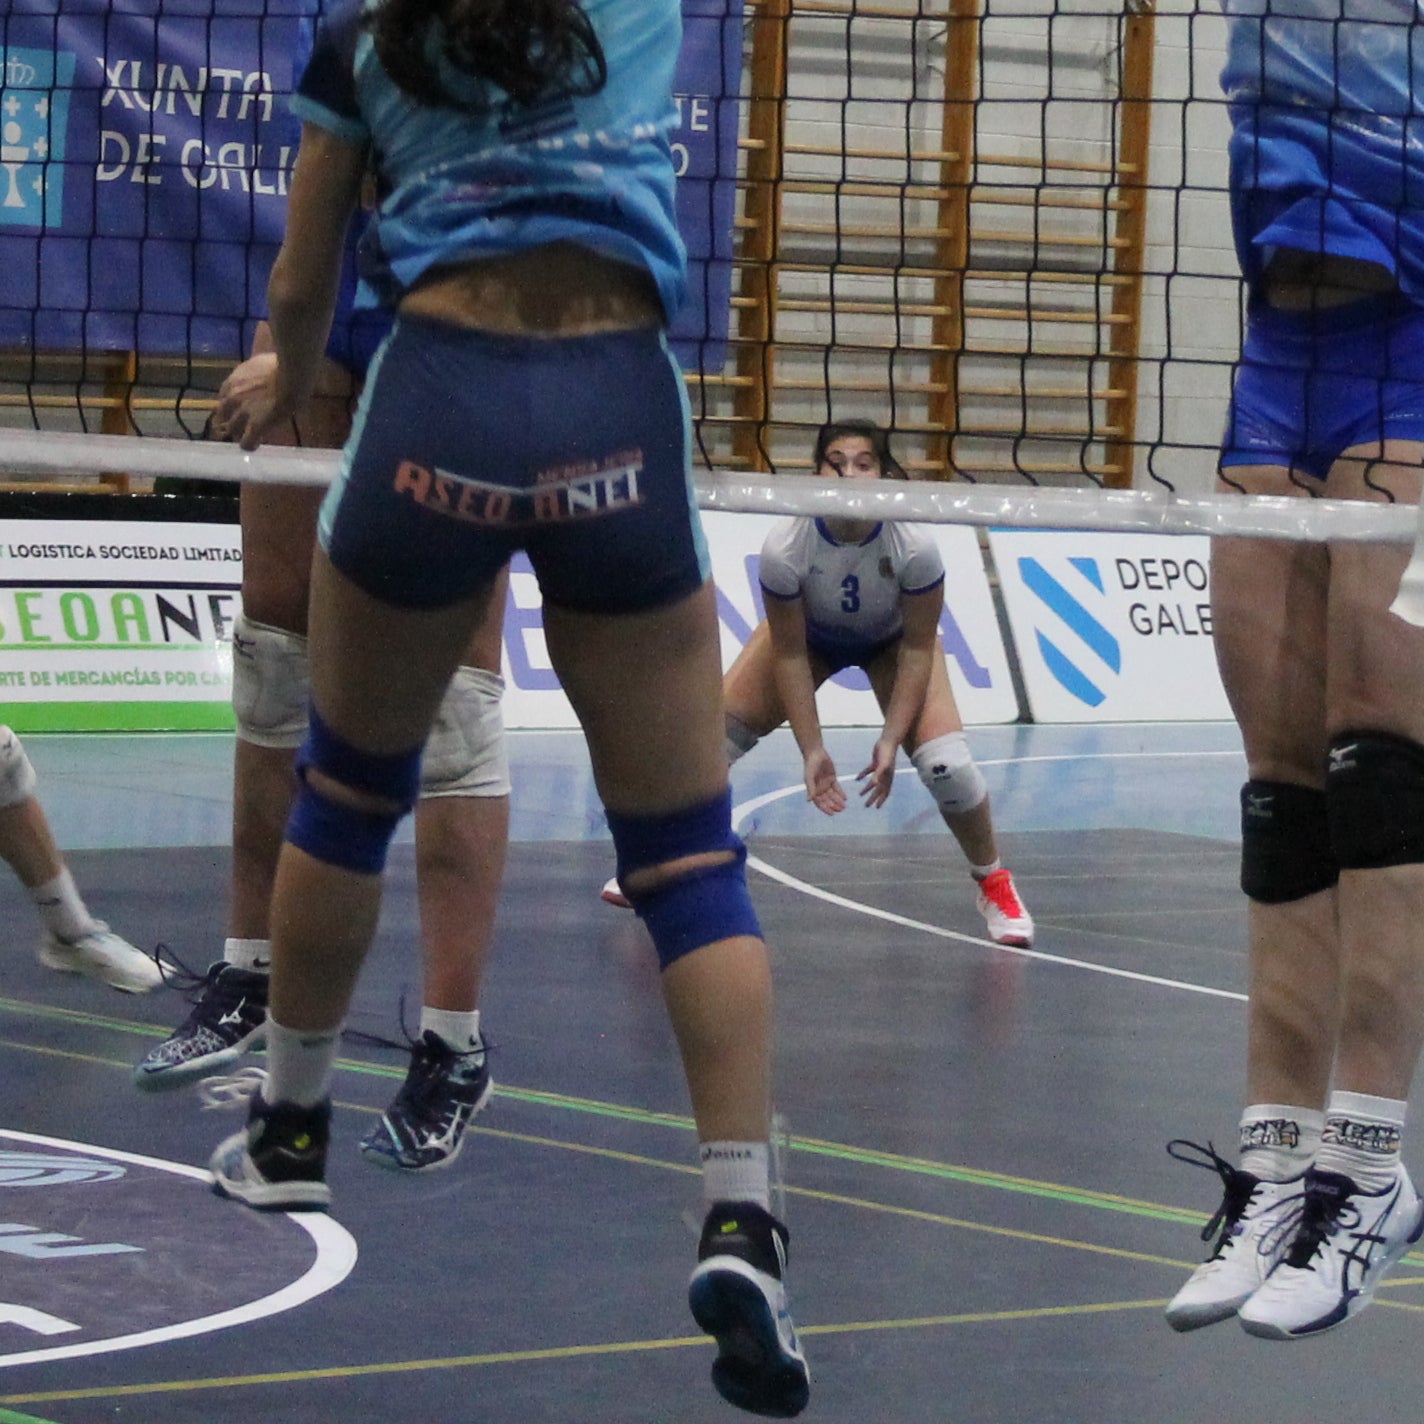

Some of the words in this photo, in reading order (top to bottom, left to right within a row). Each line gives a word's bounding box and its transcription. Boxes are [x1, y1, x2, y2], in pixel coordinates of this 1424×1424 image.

[96, 57, 274, 122] XUNTA
[96, 130, 167, 185] DE
[181, 139, 299, 196] GALI
[9, 544, 95, 560] LOGISTICA
[100, 545, 178, 561] SOCIEDAD
[840, 573, 861, 614] 3
[31, 672, 51, 687] DE
[56, 666, 161, 687] MERCANCÍAS
[166, 671, 197, 687] POR
